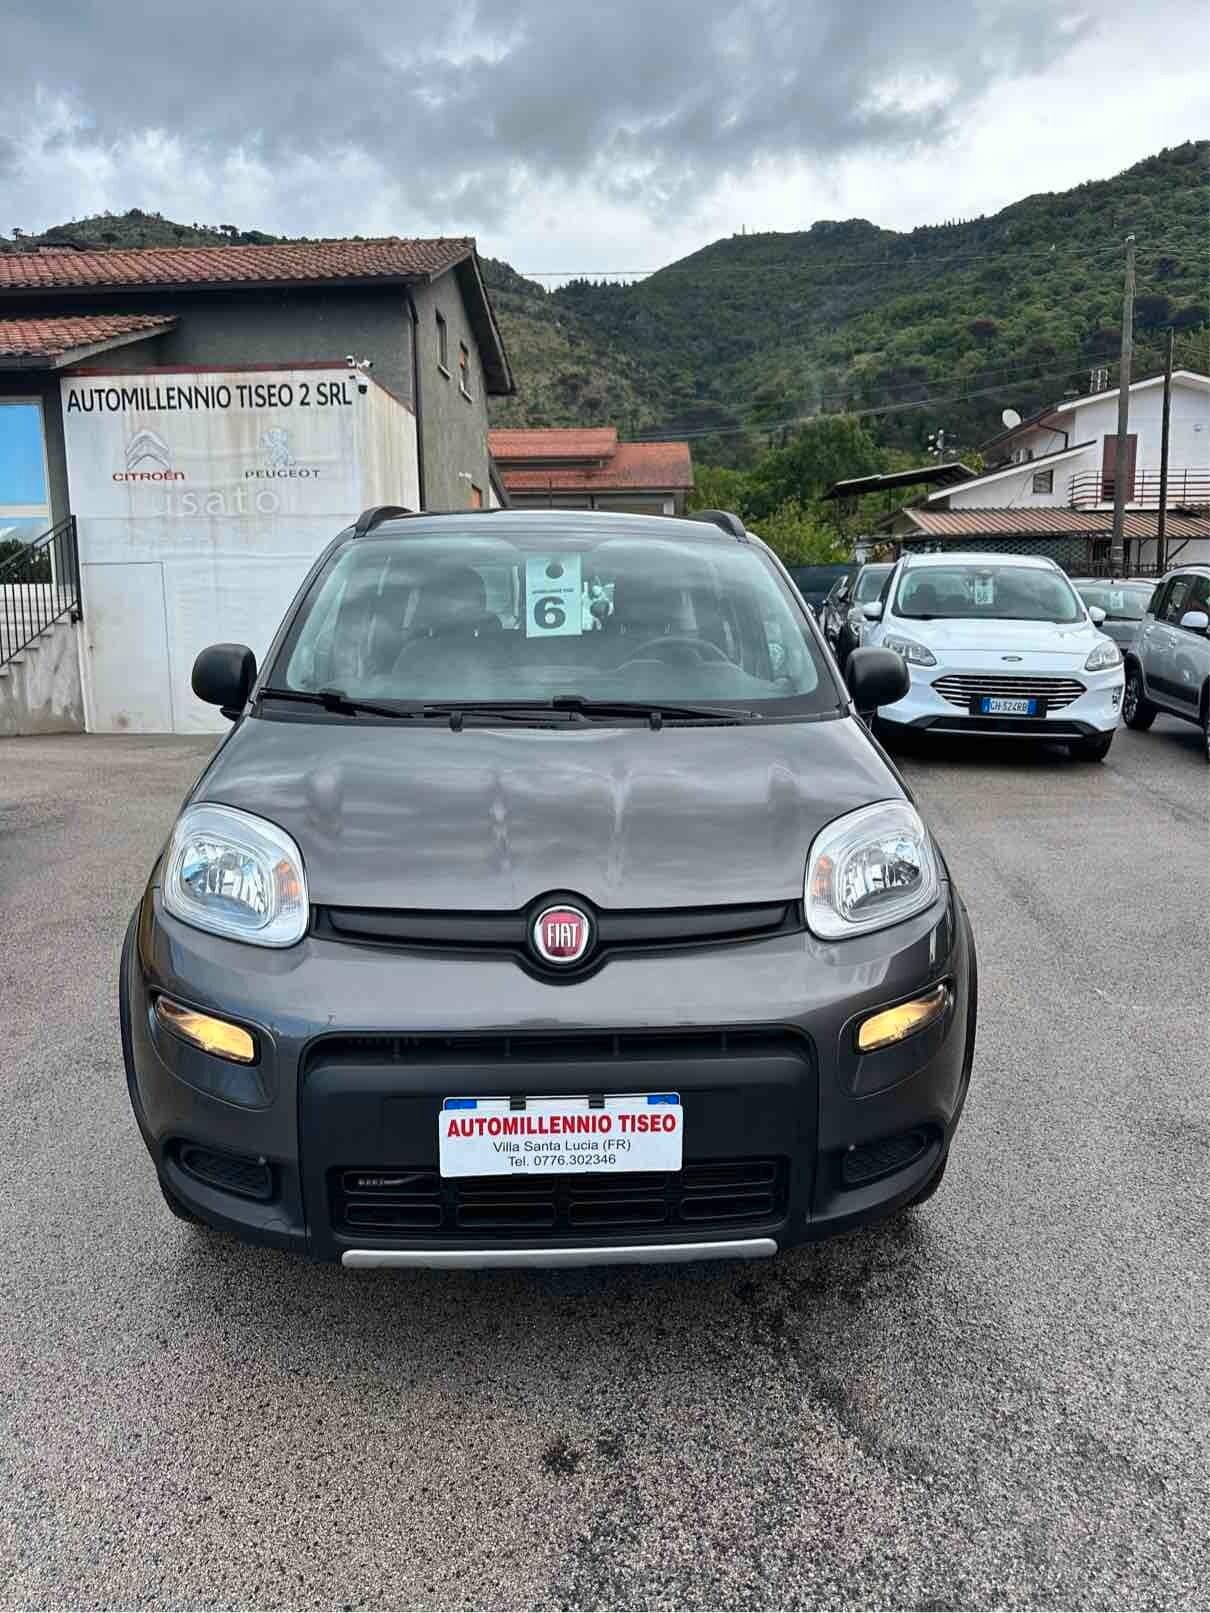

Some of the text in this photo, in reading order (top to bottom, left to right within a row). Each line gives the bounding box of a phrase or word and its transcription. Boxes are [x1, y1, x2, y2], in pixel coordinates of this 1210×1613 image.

[67, 382, 352, 412] AUTOMILLENNIO TISEO 2 SRL
[245, 469, 320, 480] PEUGEOT
[534, 596, 566, 629] 6
[547, 922, 579, 948] FIAT
[447, 1114, 676, 1137] AUTOMILLENNIO TISEO
[492, 1138, 632, 1153] Villa Santa Lucia (FR)
[508, 1154, 616, 1167] Tel. 0776.302346
